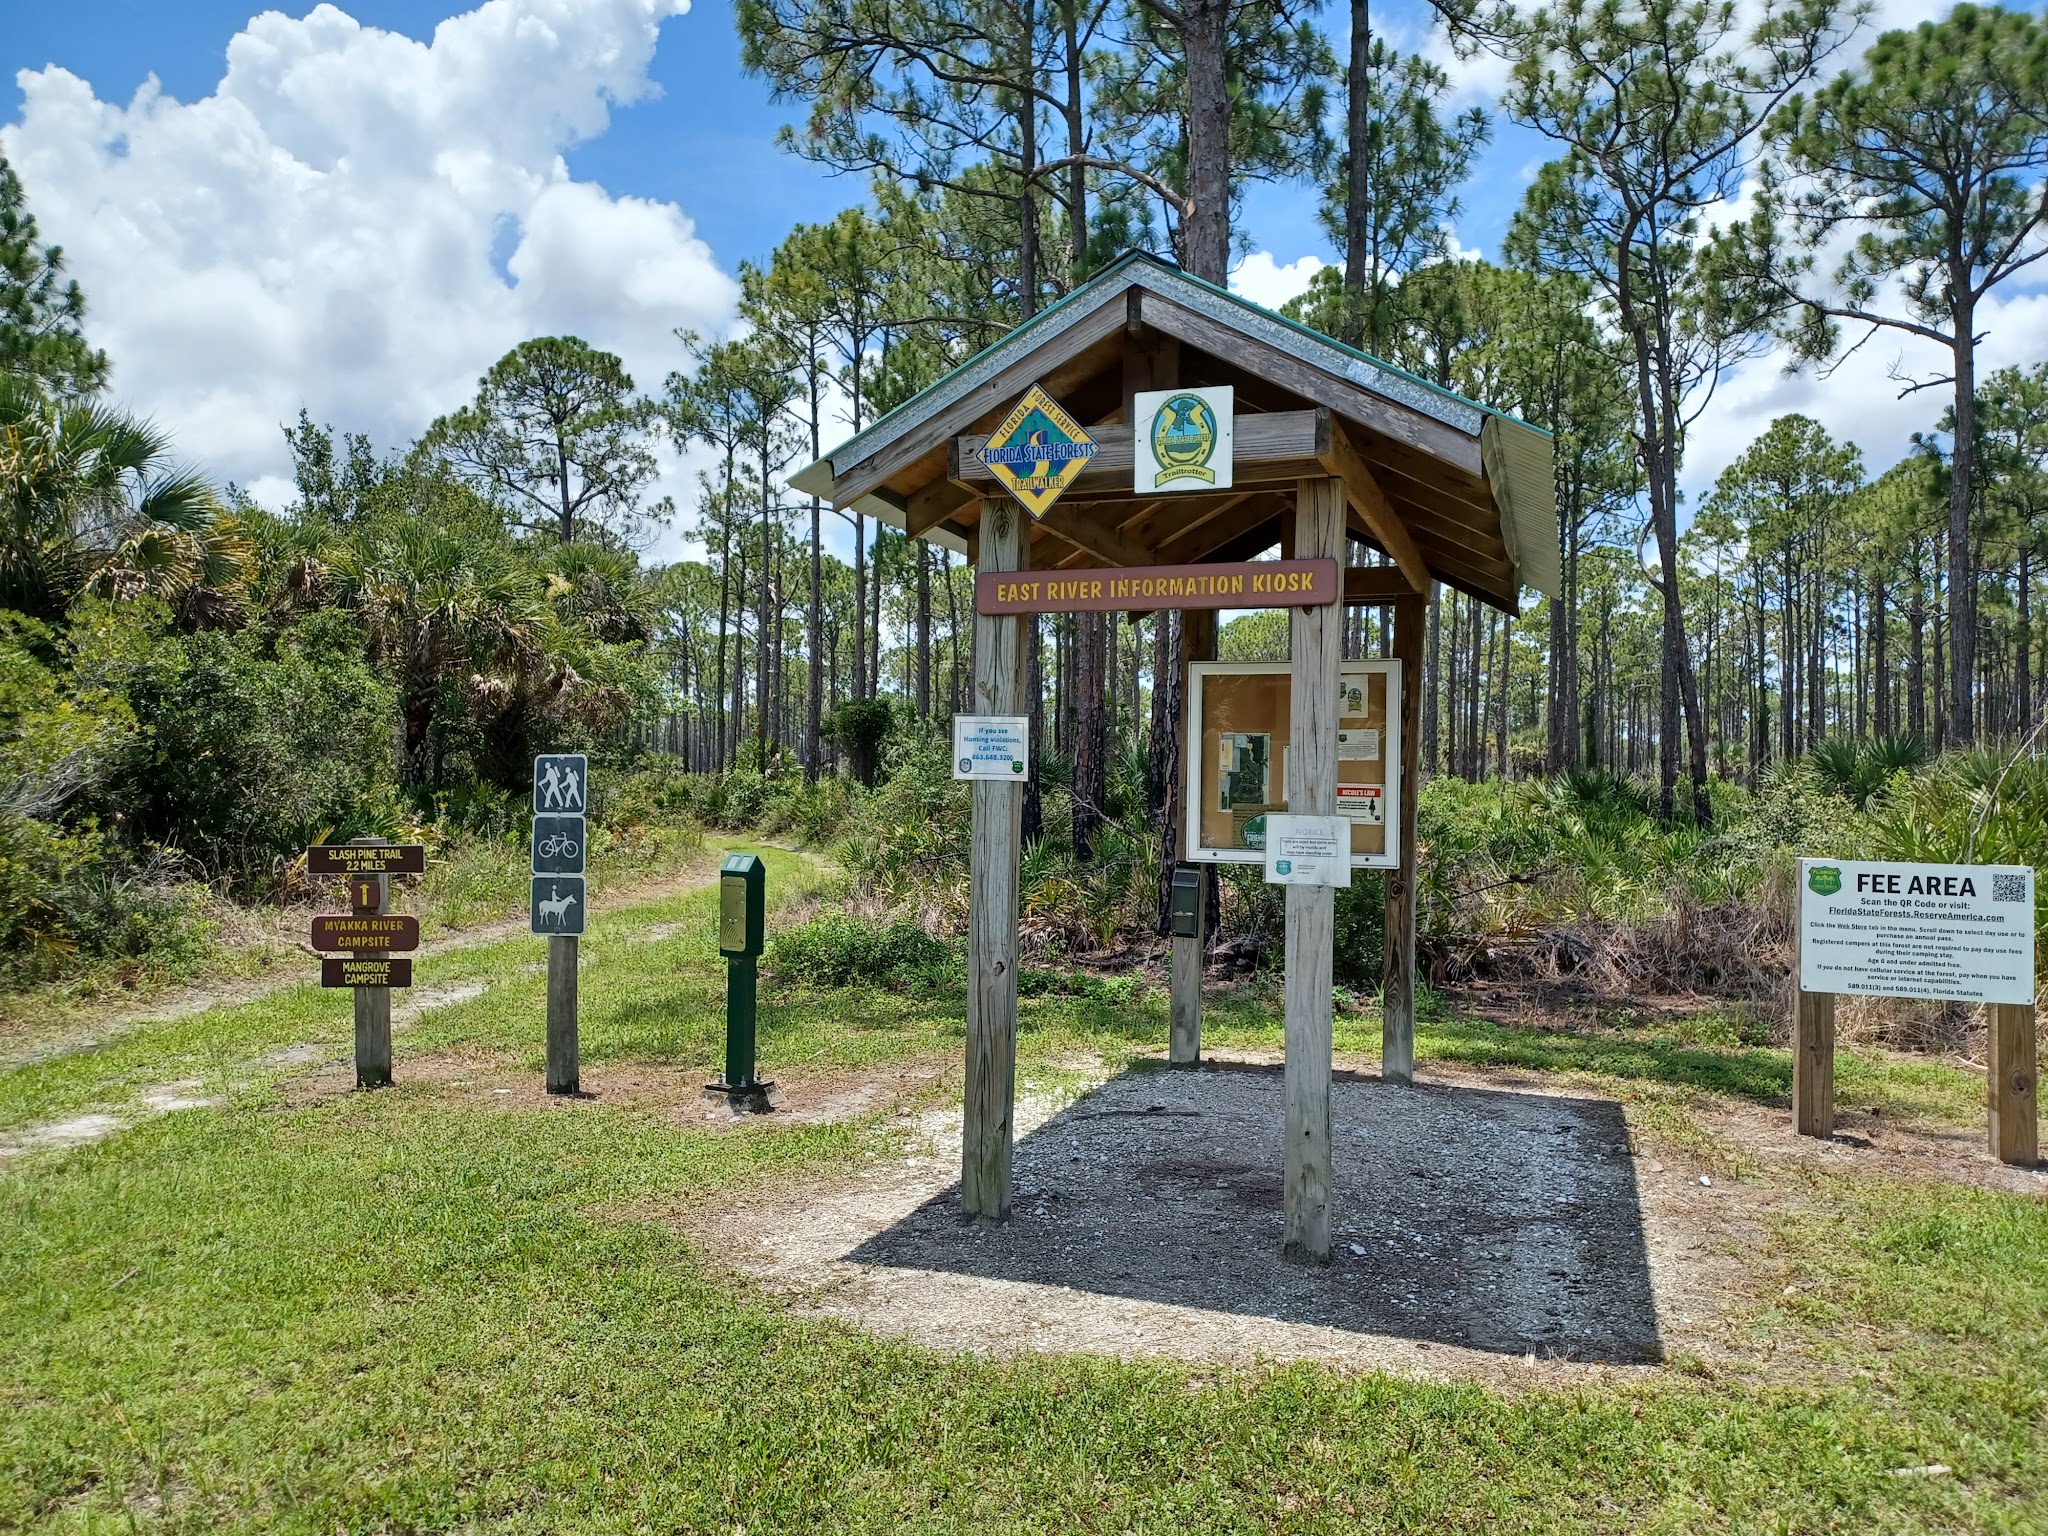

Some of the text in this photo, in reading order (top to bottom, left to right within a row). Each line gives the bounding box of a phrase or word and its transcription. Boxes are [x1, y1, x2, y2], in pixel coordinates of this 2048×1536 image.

[1000, 390, 1080, 439] FLORIDA FOREST SERVICE
[984, 442, 1094, 464] FLORIDA STATE FORESTS
[1163, 468, 1206, 479] Trailtrotter
[1011, 475, 1064, 491] TRAILWALKER
[998, 572, 1314, 602] EAST RIVER INFORMATION KIOSK
[329, 850, 403, 860] SLASH PINE TRAIL
[346, 861, 385, 870] 2.2 MILES
[1857, 874, 1976, 897] FEE AREA
[1900, 899, 1912, 907] QR
[1950, 901, 1970, 909] visit:
[1829, 907, 2005, 922] FloridaStateForests.ReserveAmerica.com
[325, 921, 404, 930] MYAKKA RIVER
[338, 937, 390, 947] CAMPSITE
[343, 962, 390, 972] MANGROVE
[345, 974, 388, 984] CAMPSITE
